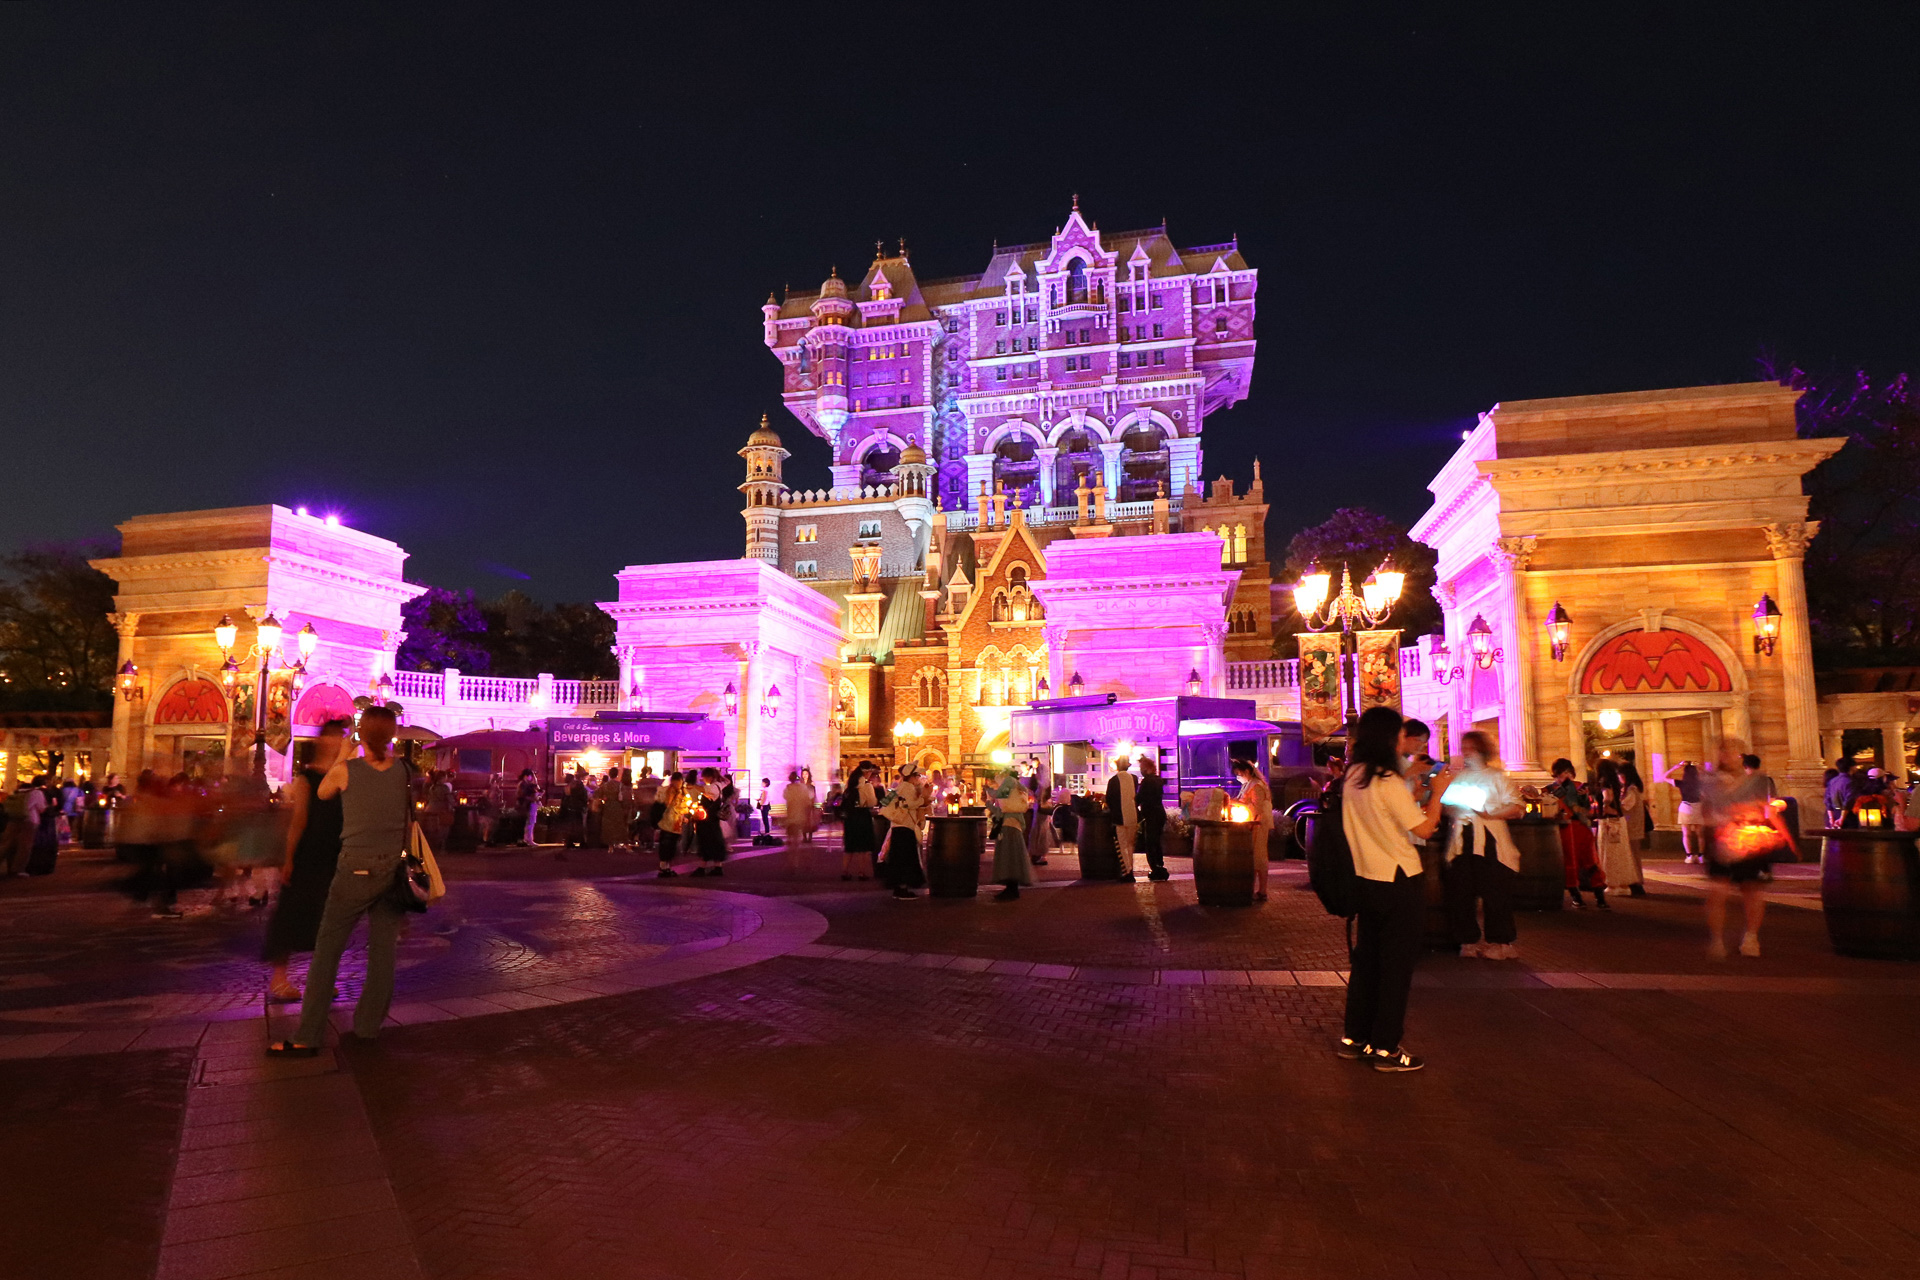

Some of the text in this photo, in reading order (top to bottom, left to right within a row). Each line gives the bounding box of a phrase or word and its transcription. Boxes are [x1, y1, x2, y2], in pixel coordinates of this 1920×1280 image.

[1554, 484, 1742, 506] THEATRE
[1096, 598, 1170, 609] DANCE
[553, 730, 650, 745] Beverages & More
[1363, 1044, 1373, 1054] N
[1400, 1054, 1411, 1066] N
